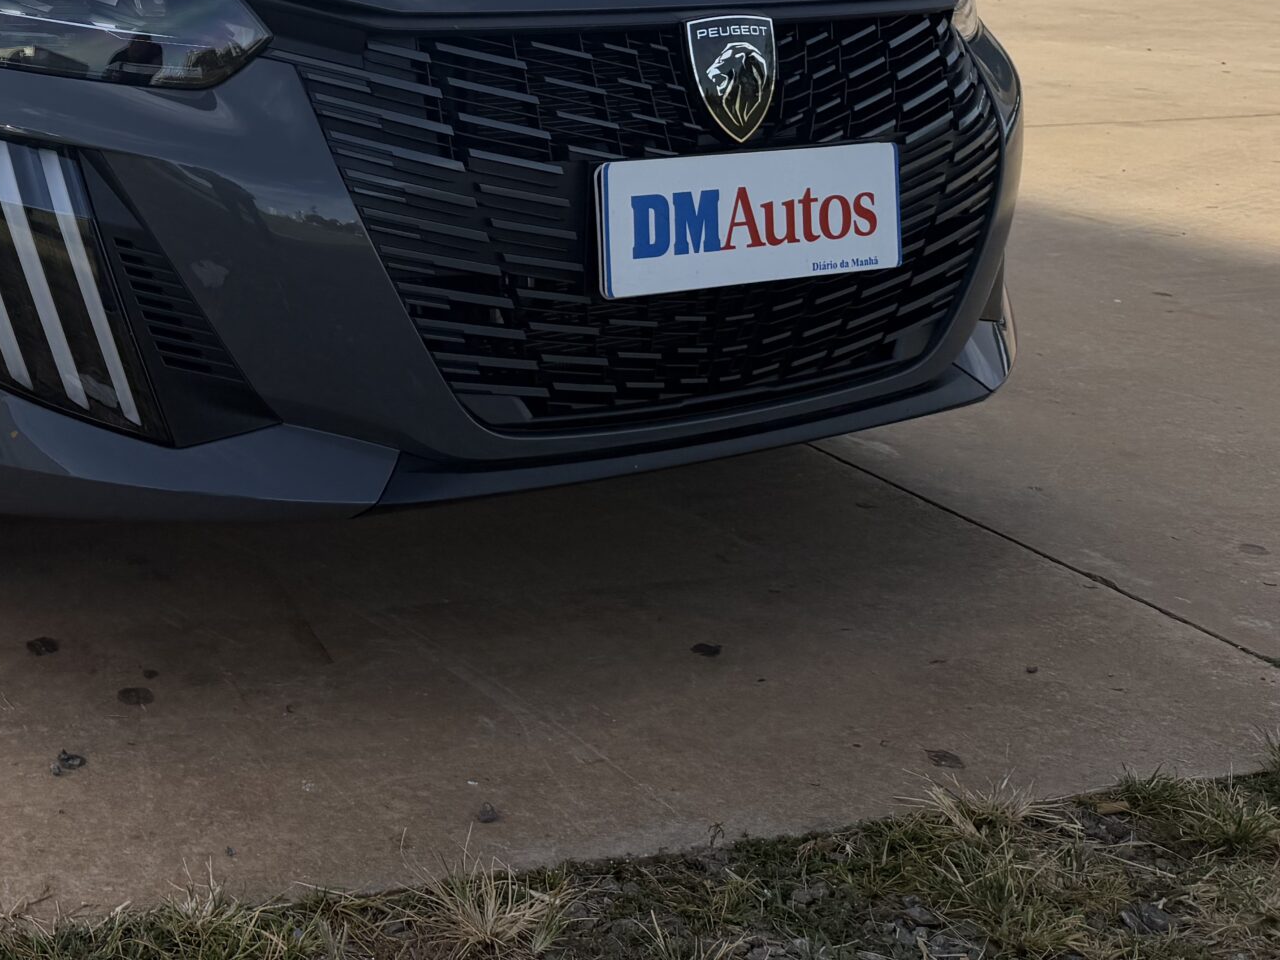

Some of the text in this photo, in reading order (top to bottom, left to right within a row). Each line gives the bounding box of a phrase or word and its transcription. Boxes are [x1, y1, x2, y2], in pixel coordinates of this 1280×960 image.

[696, 25, 768, 40] PEUGEOT
[812, 260, 838, 272] Diário
[840, 259, 849, 269] da
